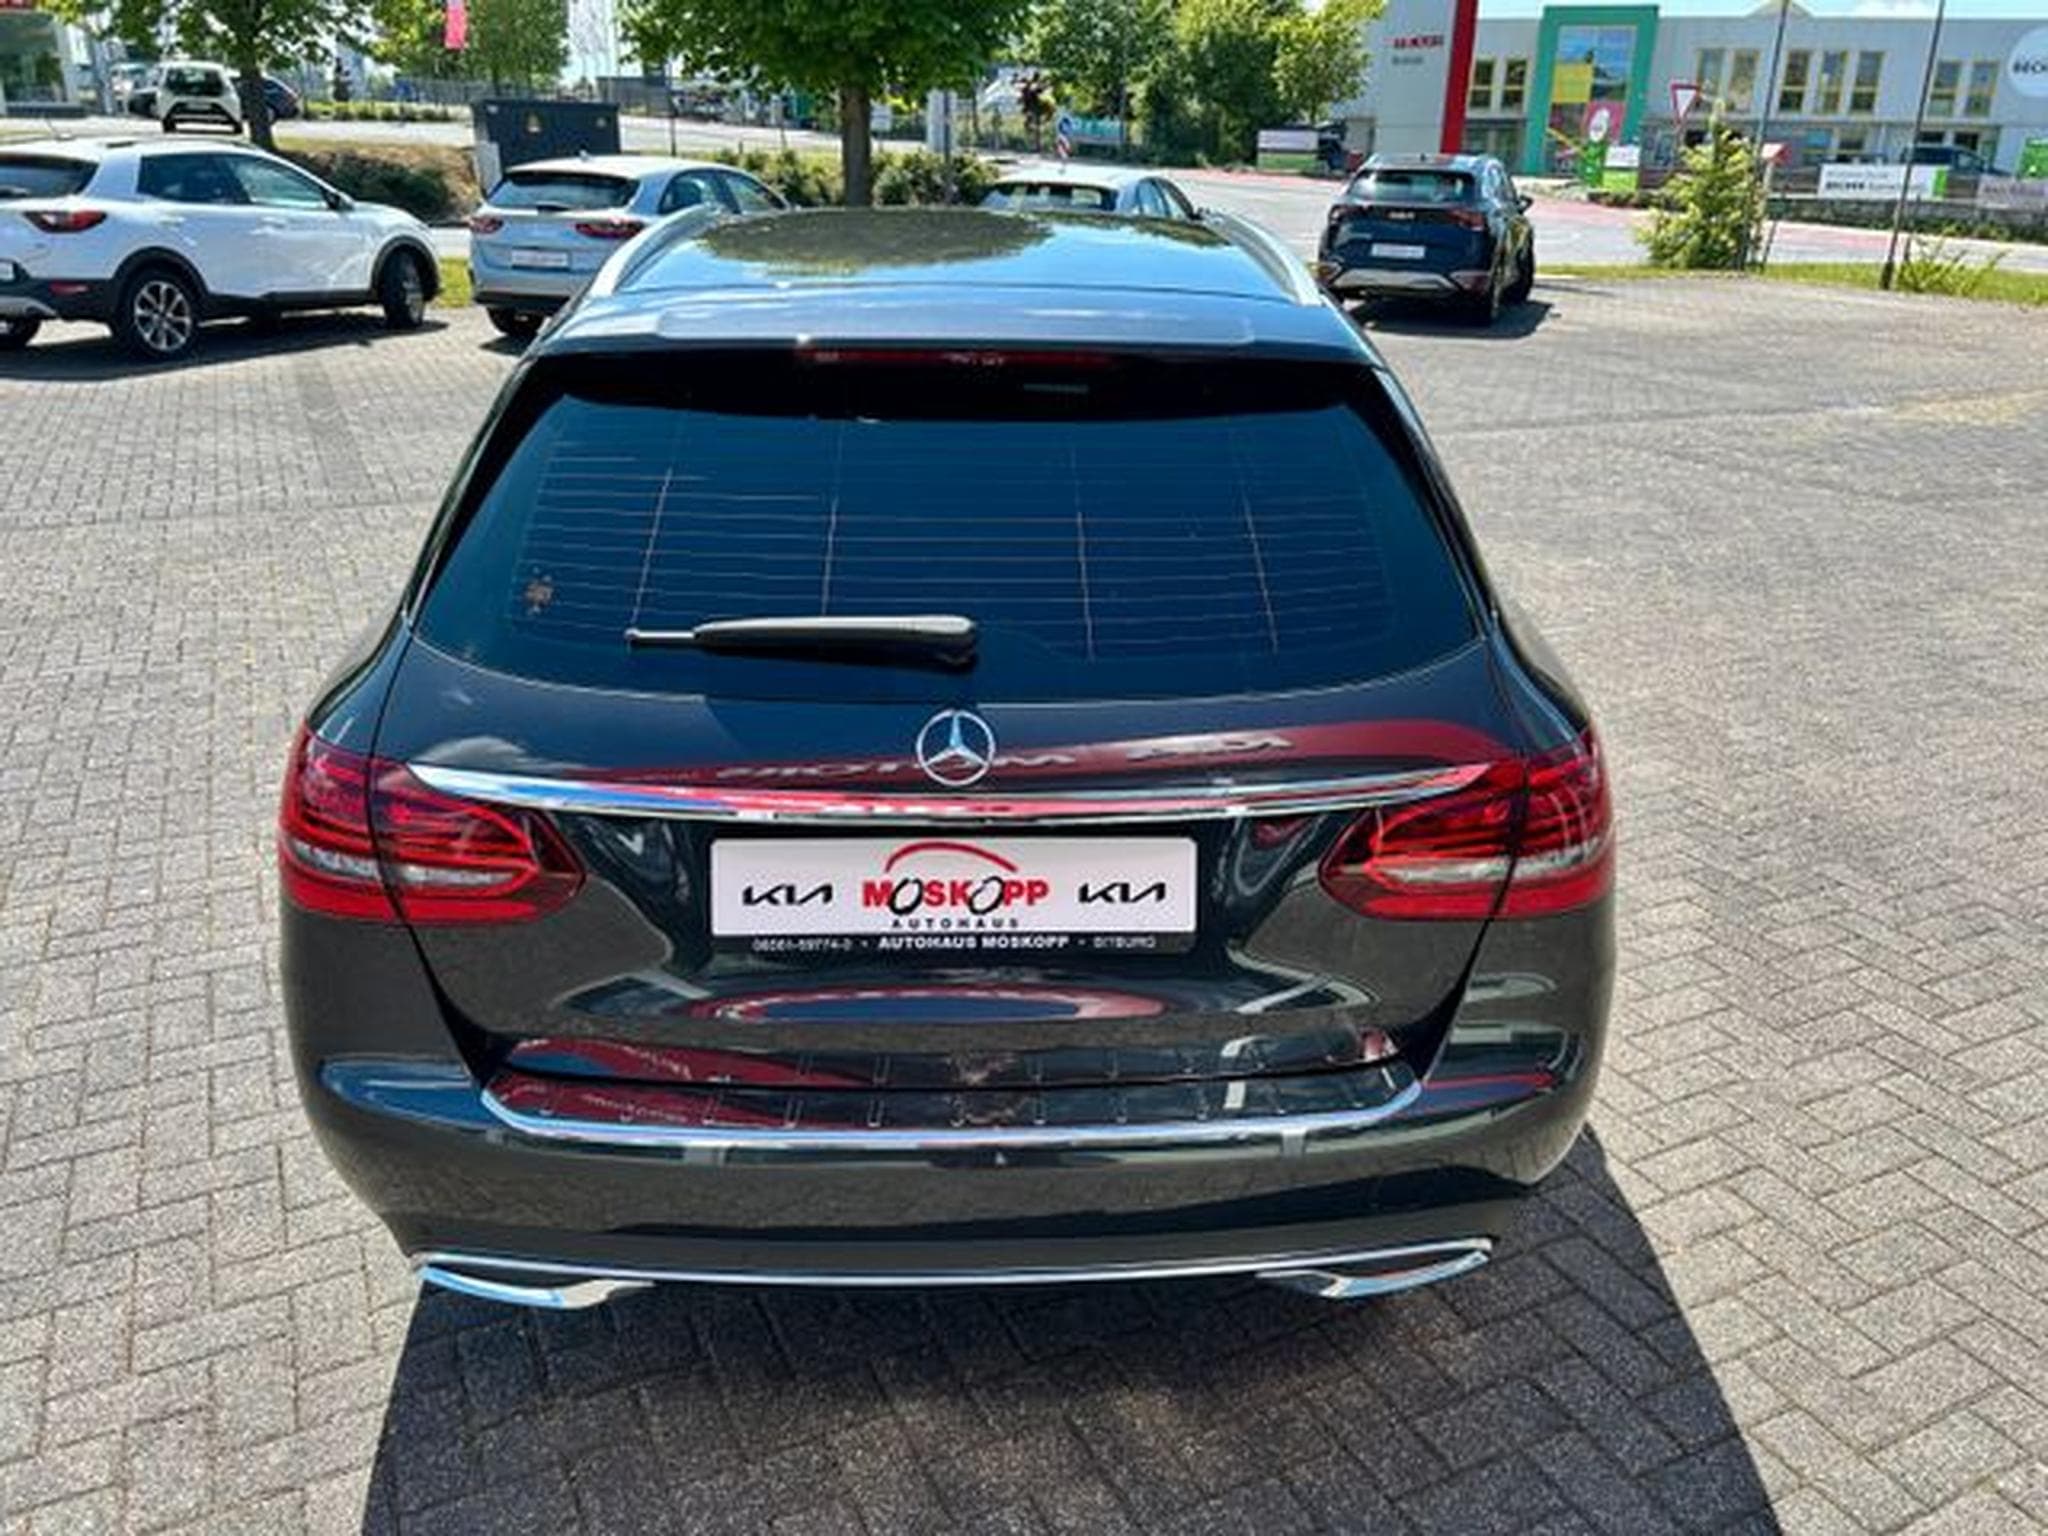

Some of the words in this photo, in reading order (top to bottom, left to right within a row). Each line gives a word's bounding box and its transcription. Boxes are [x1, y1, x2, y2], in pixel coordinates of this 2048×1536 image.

[863, 876, 1049, 915] MOSKOPP
[892, 918, 1019, 928] AUTOHAUS
[879, 936, 977, 949] AUTOHAUS
[981, 935, 1069, 949] MOSKOPP
